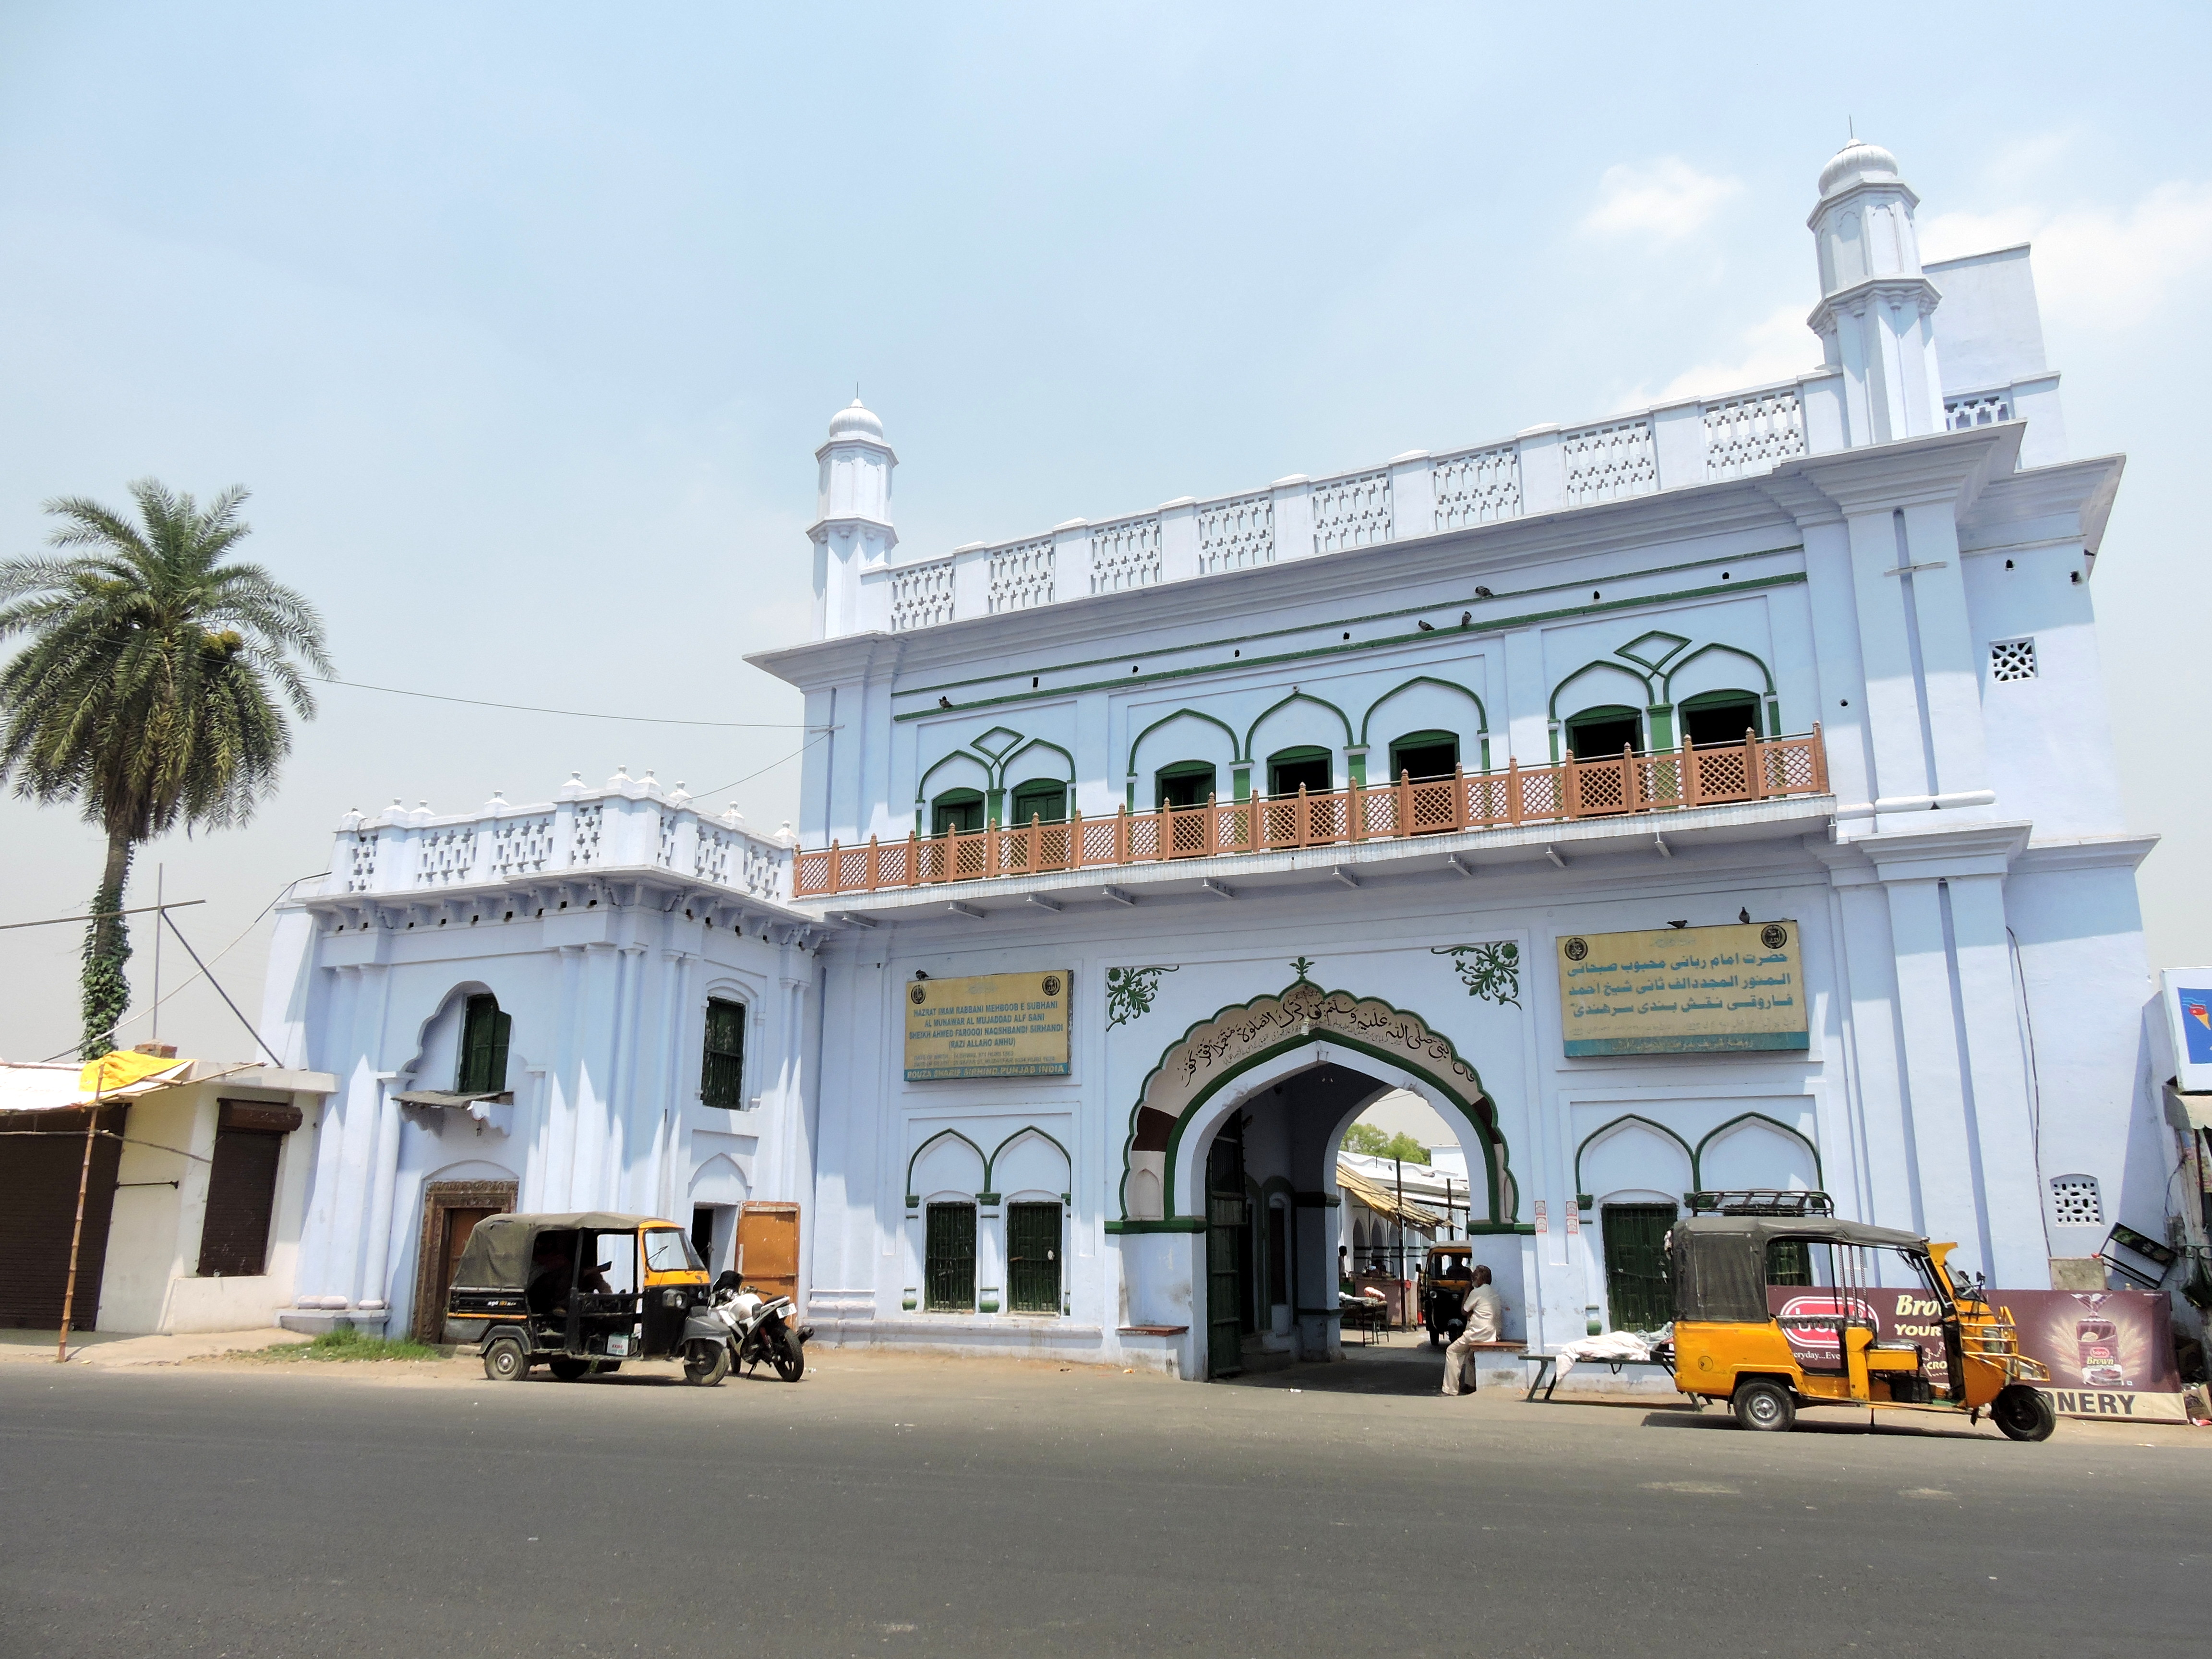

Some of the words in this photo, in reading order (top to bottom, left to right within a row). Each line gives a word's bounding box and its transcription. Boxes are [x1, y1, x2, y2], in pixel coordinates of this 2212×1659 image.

[914, 1008, 936, 1017] HAZRAT
[956, 1006, 983, 1014] RABBANI
[986, 1003, 1018, 1012] MEHBOOB
[1027, 1001, 1058, 1010] SUBHANI
[976, 1015, 1011, 1024] MUJADDAD
[1014, 1014, 1026, 1022] ALF
[1028, 1013, 1044, 1022] SANI
[933, 1030, 953, 1038] AHMED
[1030, 1024, 1063, 1033] SIRHANDI
[967, 1039, 992, 1048] ALLAHO
[1896, 1295, 1942, 1316] Bro
[1894, 1323, 1942, 1336] YOUR
[2087, 1356, 2114, 1365] Brown
